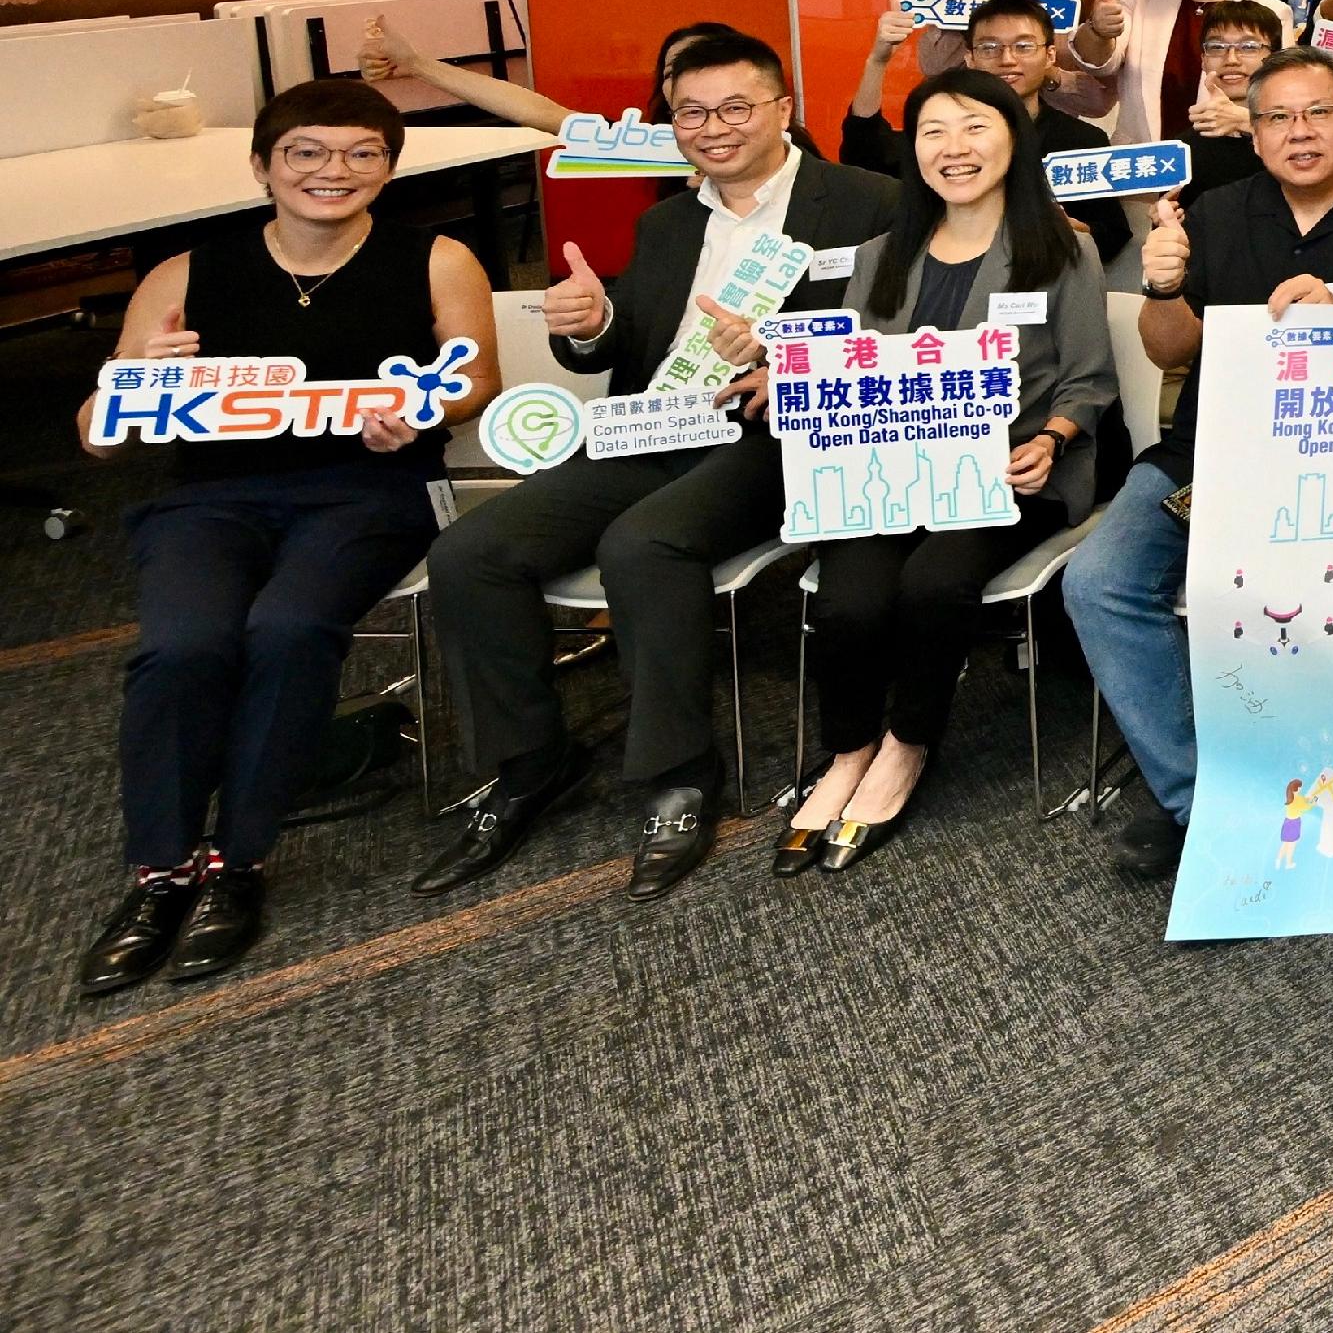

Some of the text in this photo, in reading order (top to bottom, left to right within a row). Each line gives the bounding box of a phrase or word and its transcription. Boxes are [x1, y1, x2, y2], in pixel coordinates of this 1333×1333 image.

[766, 245, 808, 292] Lab
[775, 329, 1012, 375] 滬港合作
[111, 365, 297, 390] 香港科技園
[776, 367, 1013, 415] 開放數據競賽
[102, 386, 407, 439] HKSTP
[594, 411, 721, 438] Common Spatial
[778, 401, 1013, 435] Hong Kong/Shanghai Co-op
[594, 426, 737, 454] Data Infrastructure
[808, 421, 992, 452] Open Data Challenge
[1272, 421, 1312, 438] Hong
